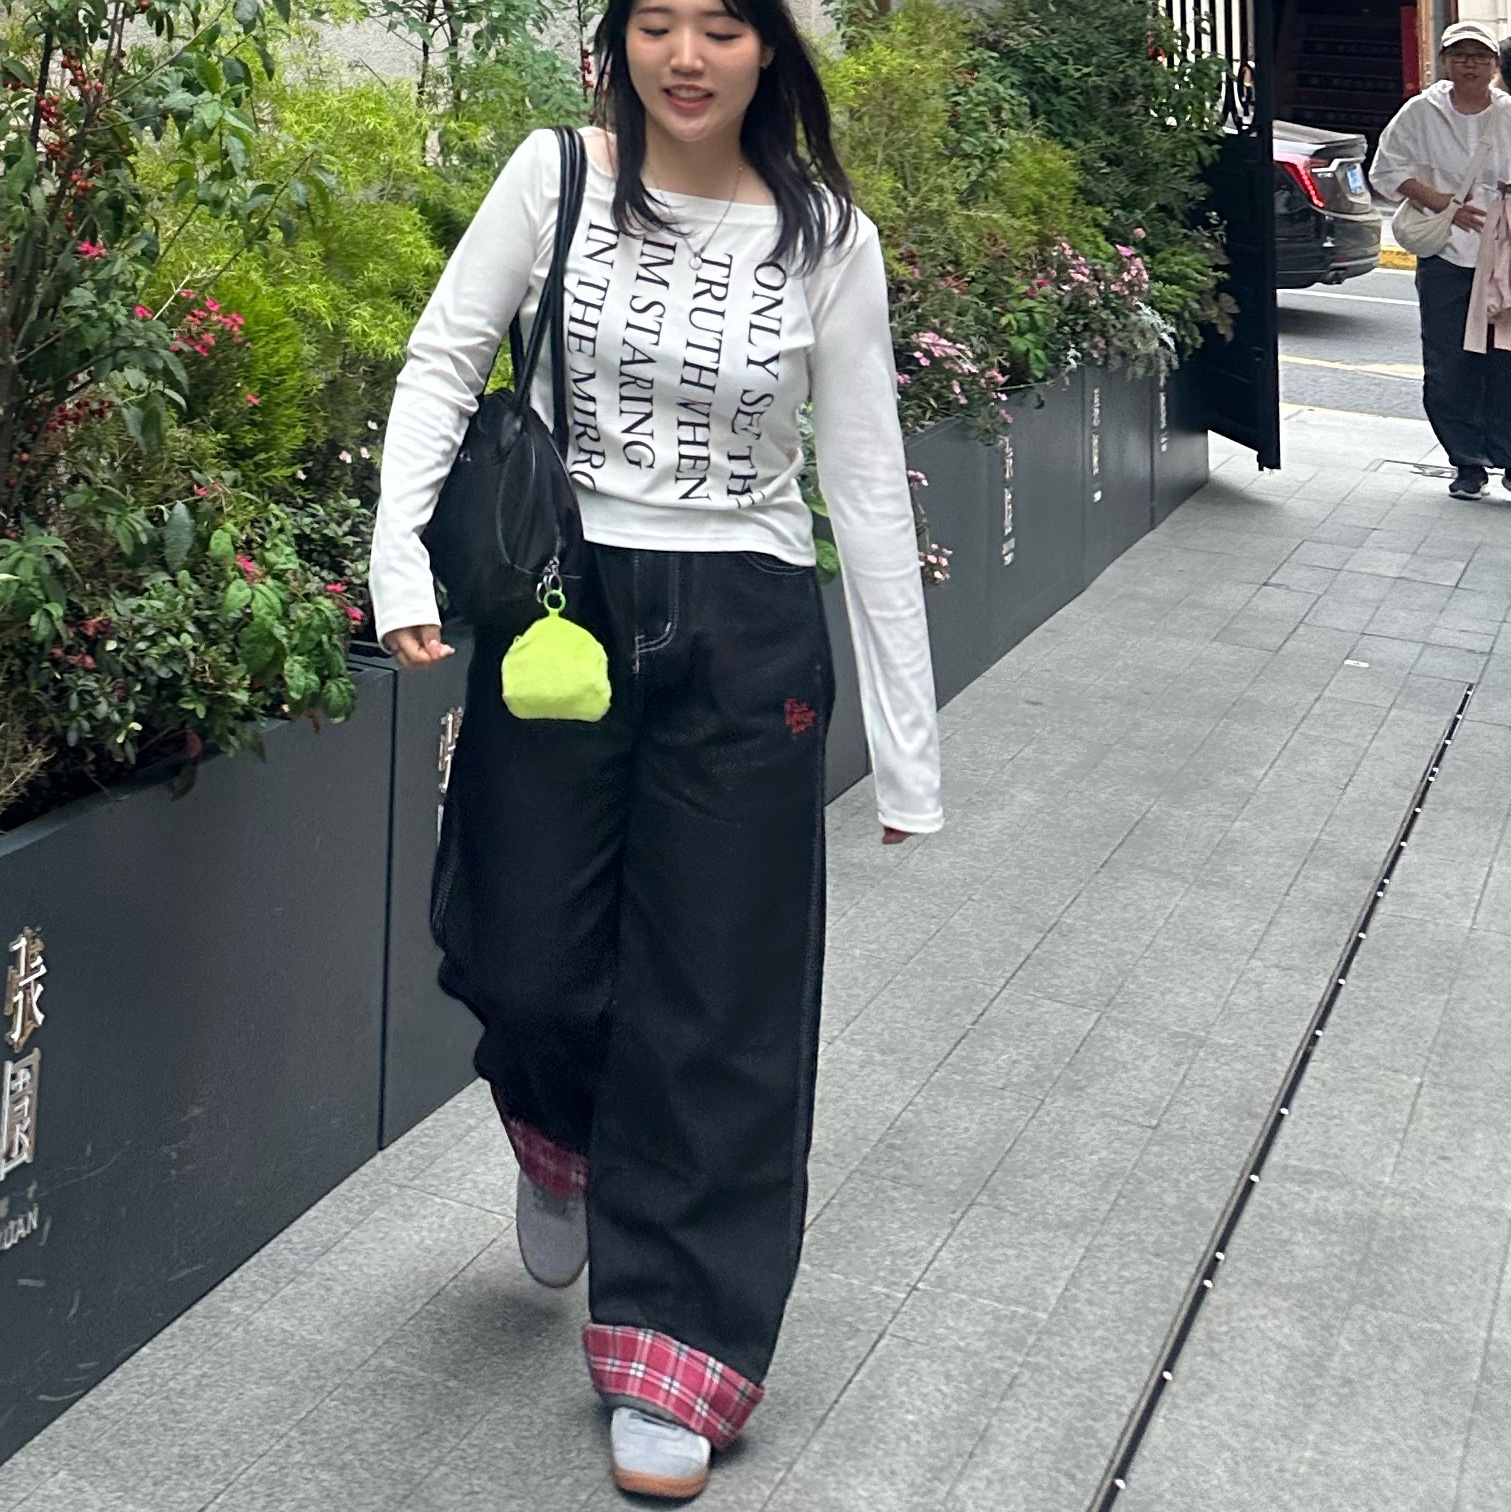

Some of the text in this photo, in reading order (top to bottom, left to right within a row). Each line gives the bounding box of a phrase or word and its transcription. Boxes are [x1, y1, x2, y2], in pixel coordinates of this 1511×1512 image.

[583, 219, 620, 269] IN
[567, 276, 611, 359] THE
[619, 237, 677, 471] IM STARING
[674, 252, 734, 501] TRUTH WHEN
[746, 261, 787, 381] ONLY
